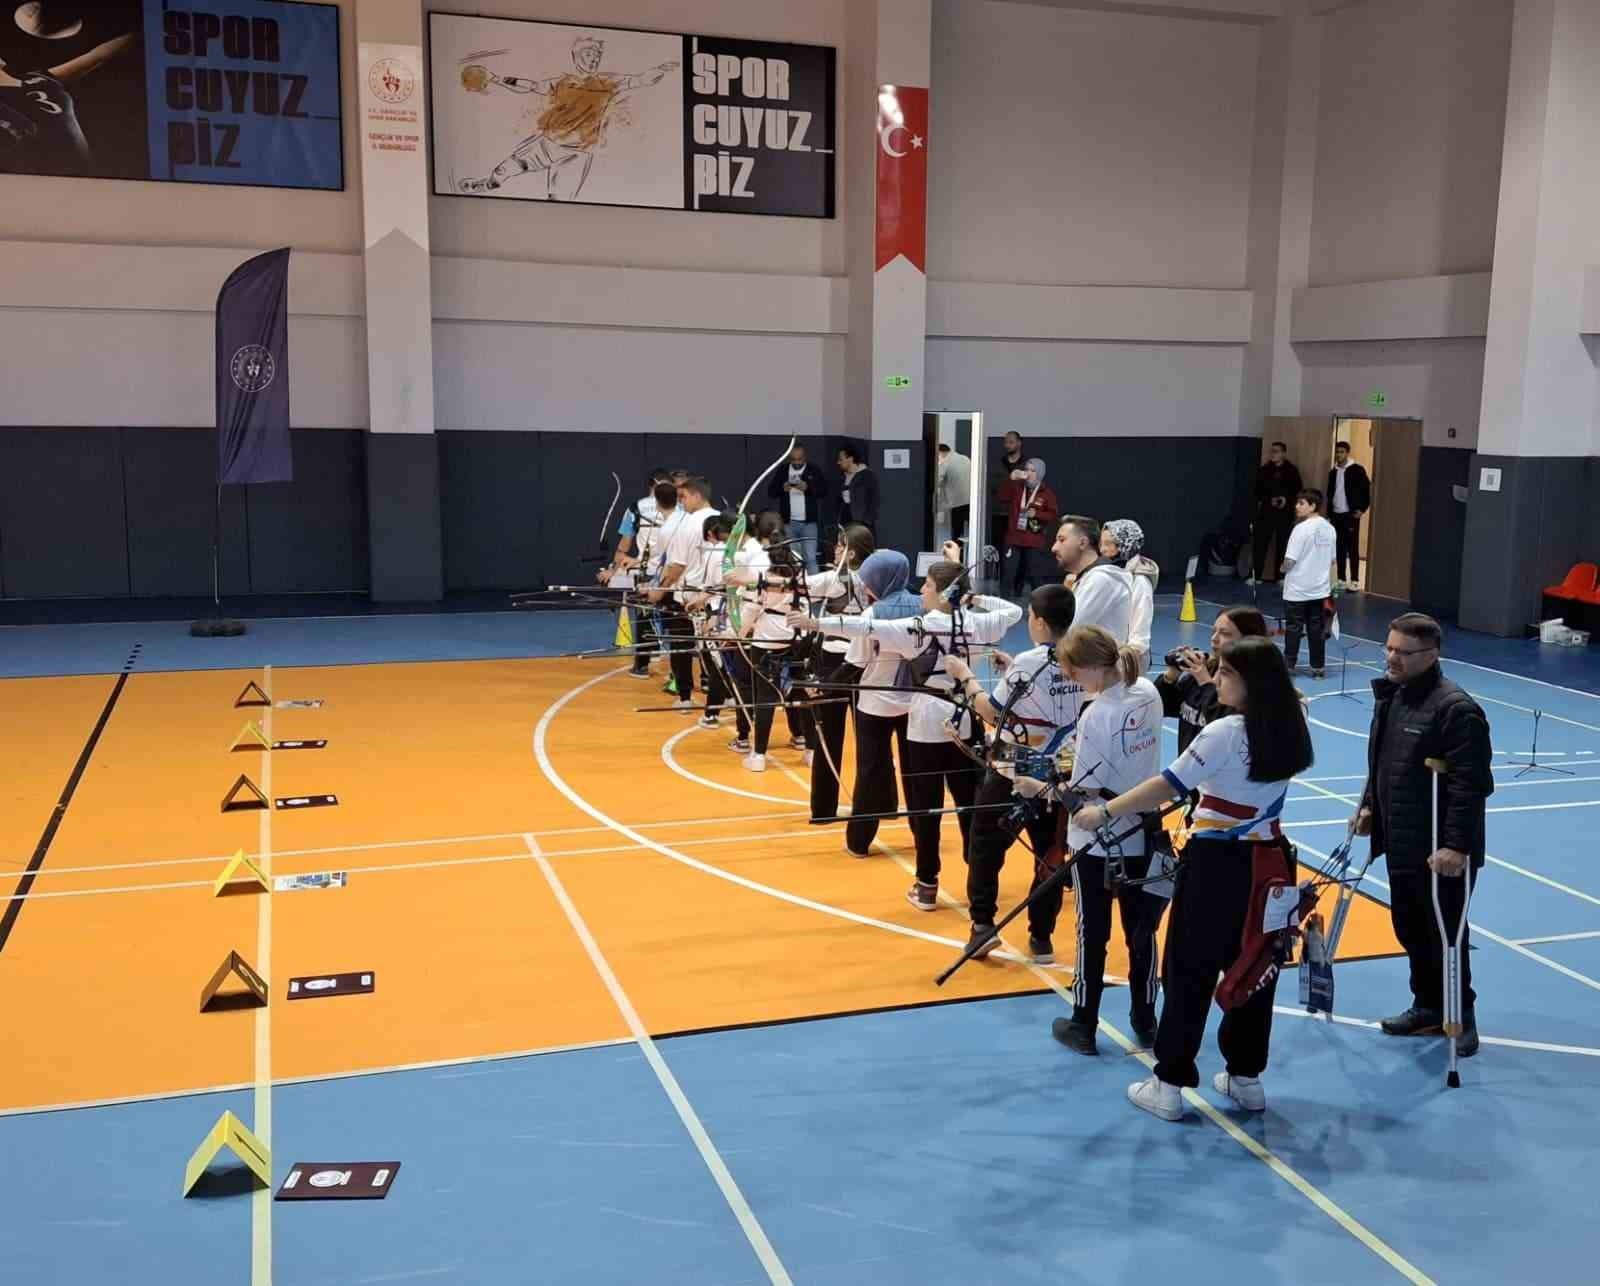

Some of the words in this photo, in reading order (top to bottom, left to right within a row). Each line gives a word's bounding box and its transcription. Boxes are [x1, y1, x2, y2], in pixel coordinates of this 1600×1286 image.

[164, 11, 280, 62] SPOR
[166, 67, 309, 118] CUYUZ
[693, 53, 789, 100] SPOR
[693, 104, 812, 152] CUYUZ
